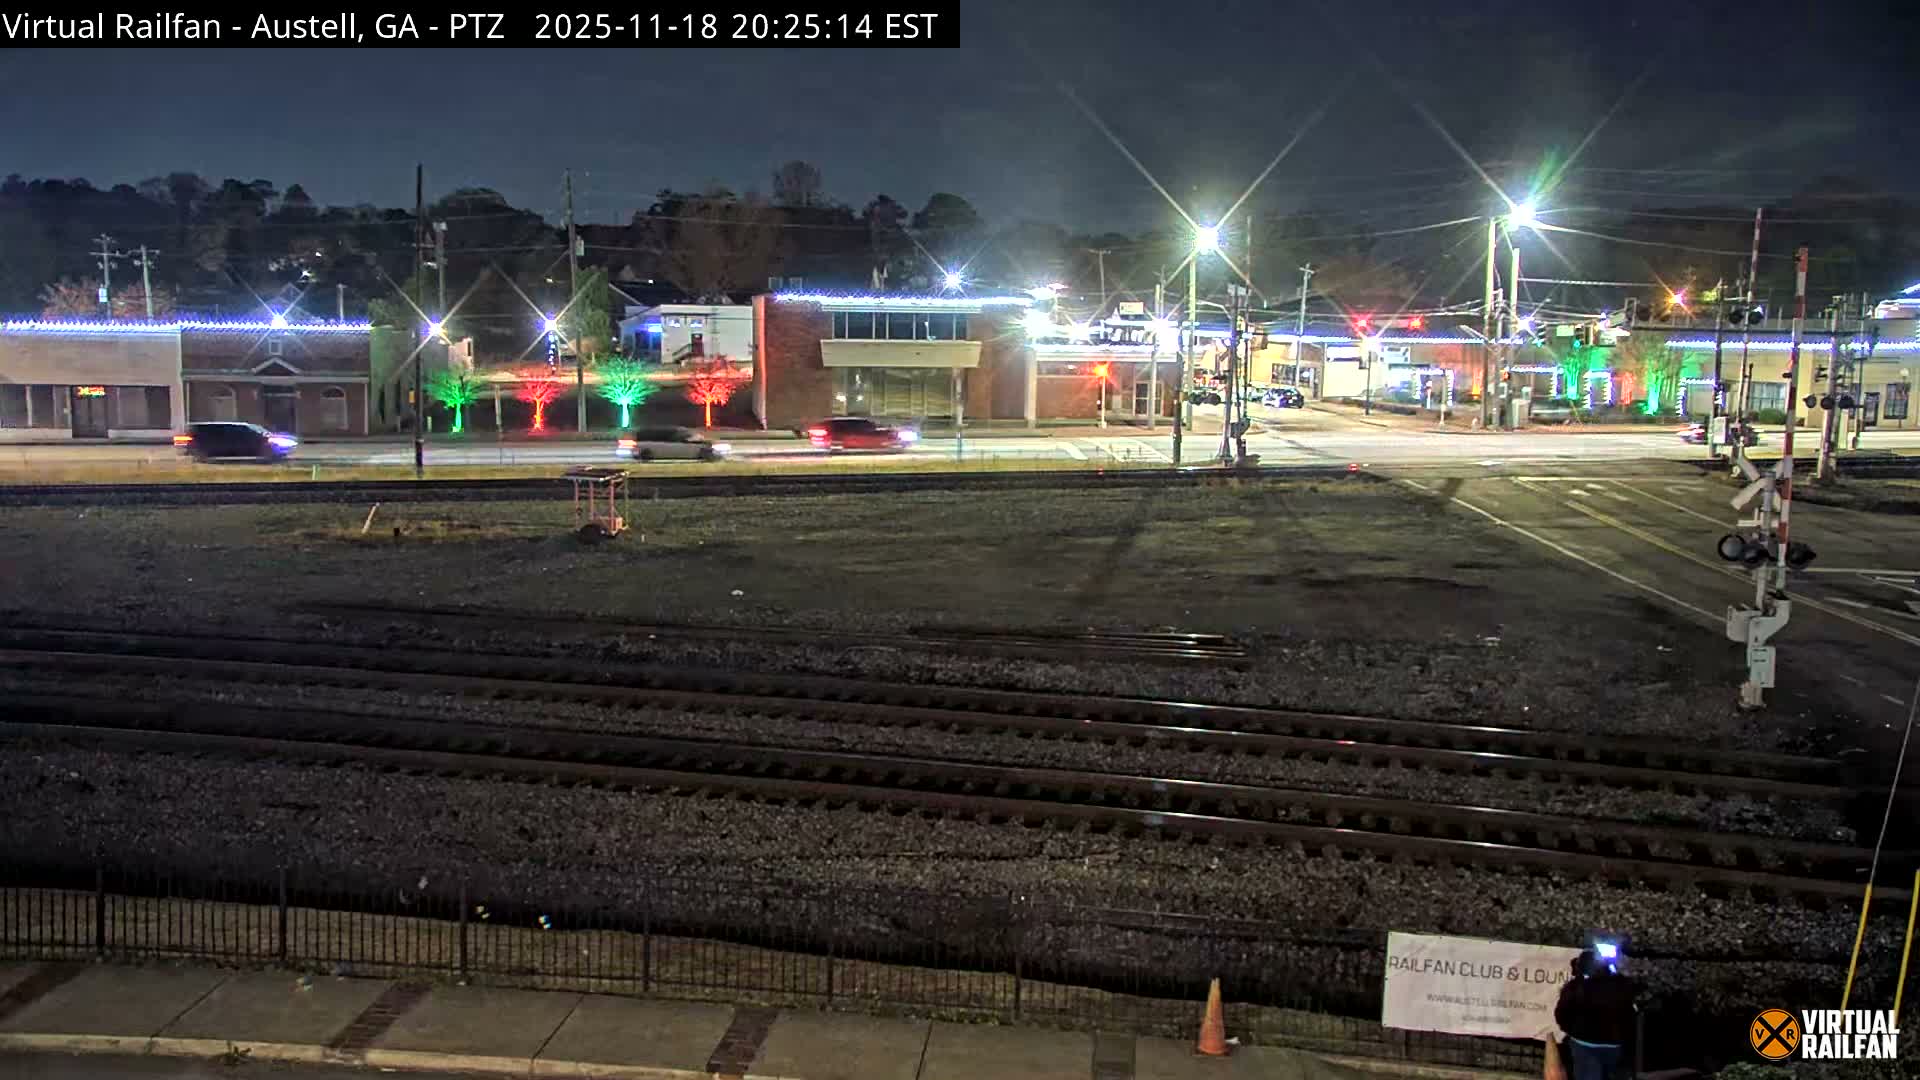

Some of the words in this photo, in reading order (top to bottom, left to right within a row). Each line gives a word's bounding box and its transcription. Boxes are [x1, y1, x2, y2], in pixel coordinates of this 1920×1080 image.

[1388, 955, 1456, 977] RAILFAN
[1459, 961, 1504, 979] CLUB
[1506, 966, 1520, 981] &
[1524, 968, 1570, 985] LOUN
